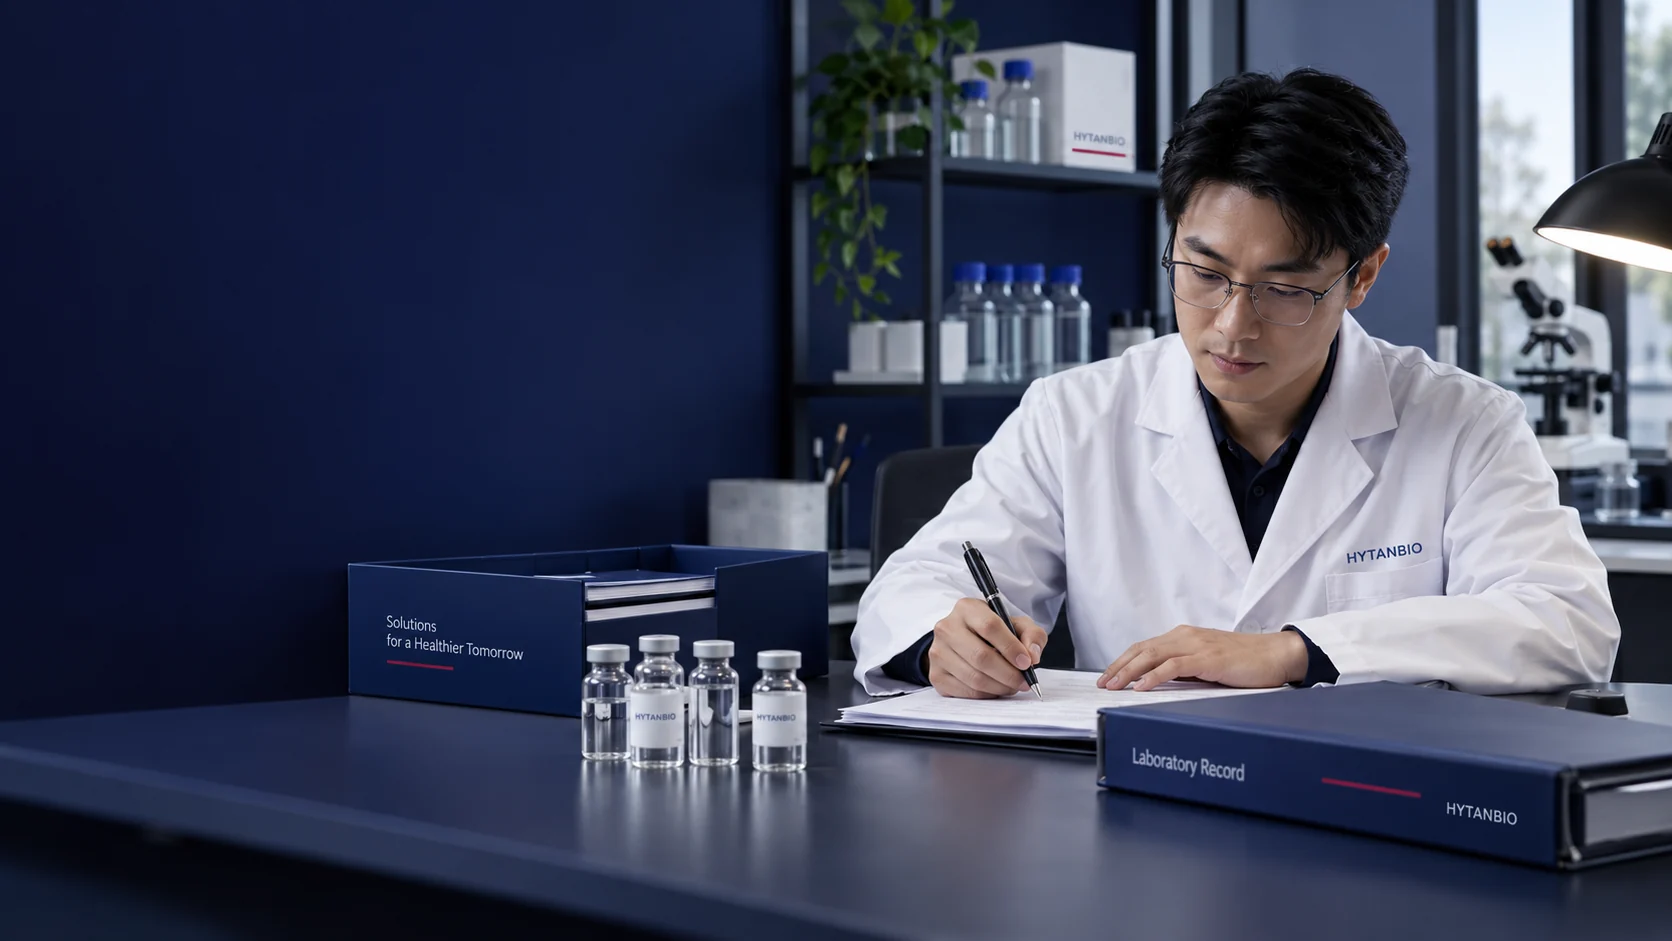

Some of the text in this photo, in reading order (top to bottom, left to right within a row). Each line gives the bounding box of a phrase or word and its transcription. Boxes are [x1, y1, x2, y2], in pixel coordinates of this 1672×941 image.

[1073, 131, 1126, 146] HYTANBIO
[1346, 542, 1422, 564] HYTANBIO
[386, 615, 437, 633] Solutions
[386, 633, 523, 660] for a Healthier Tomorrow
[634, 712, 676, 721] HYTANBIO
[1132, 747, 1245, 782] Laboratory Record
[1446, 801, 1518, 826] HYTANBIO
